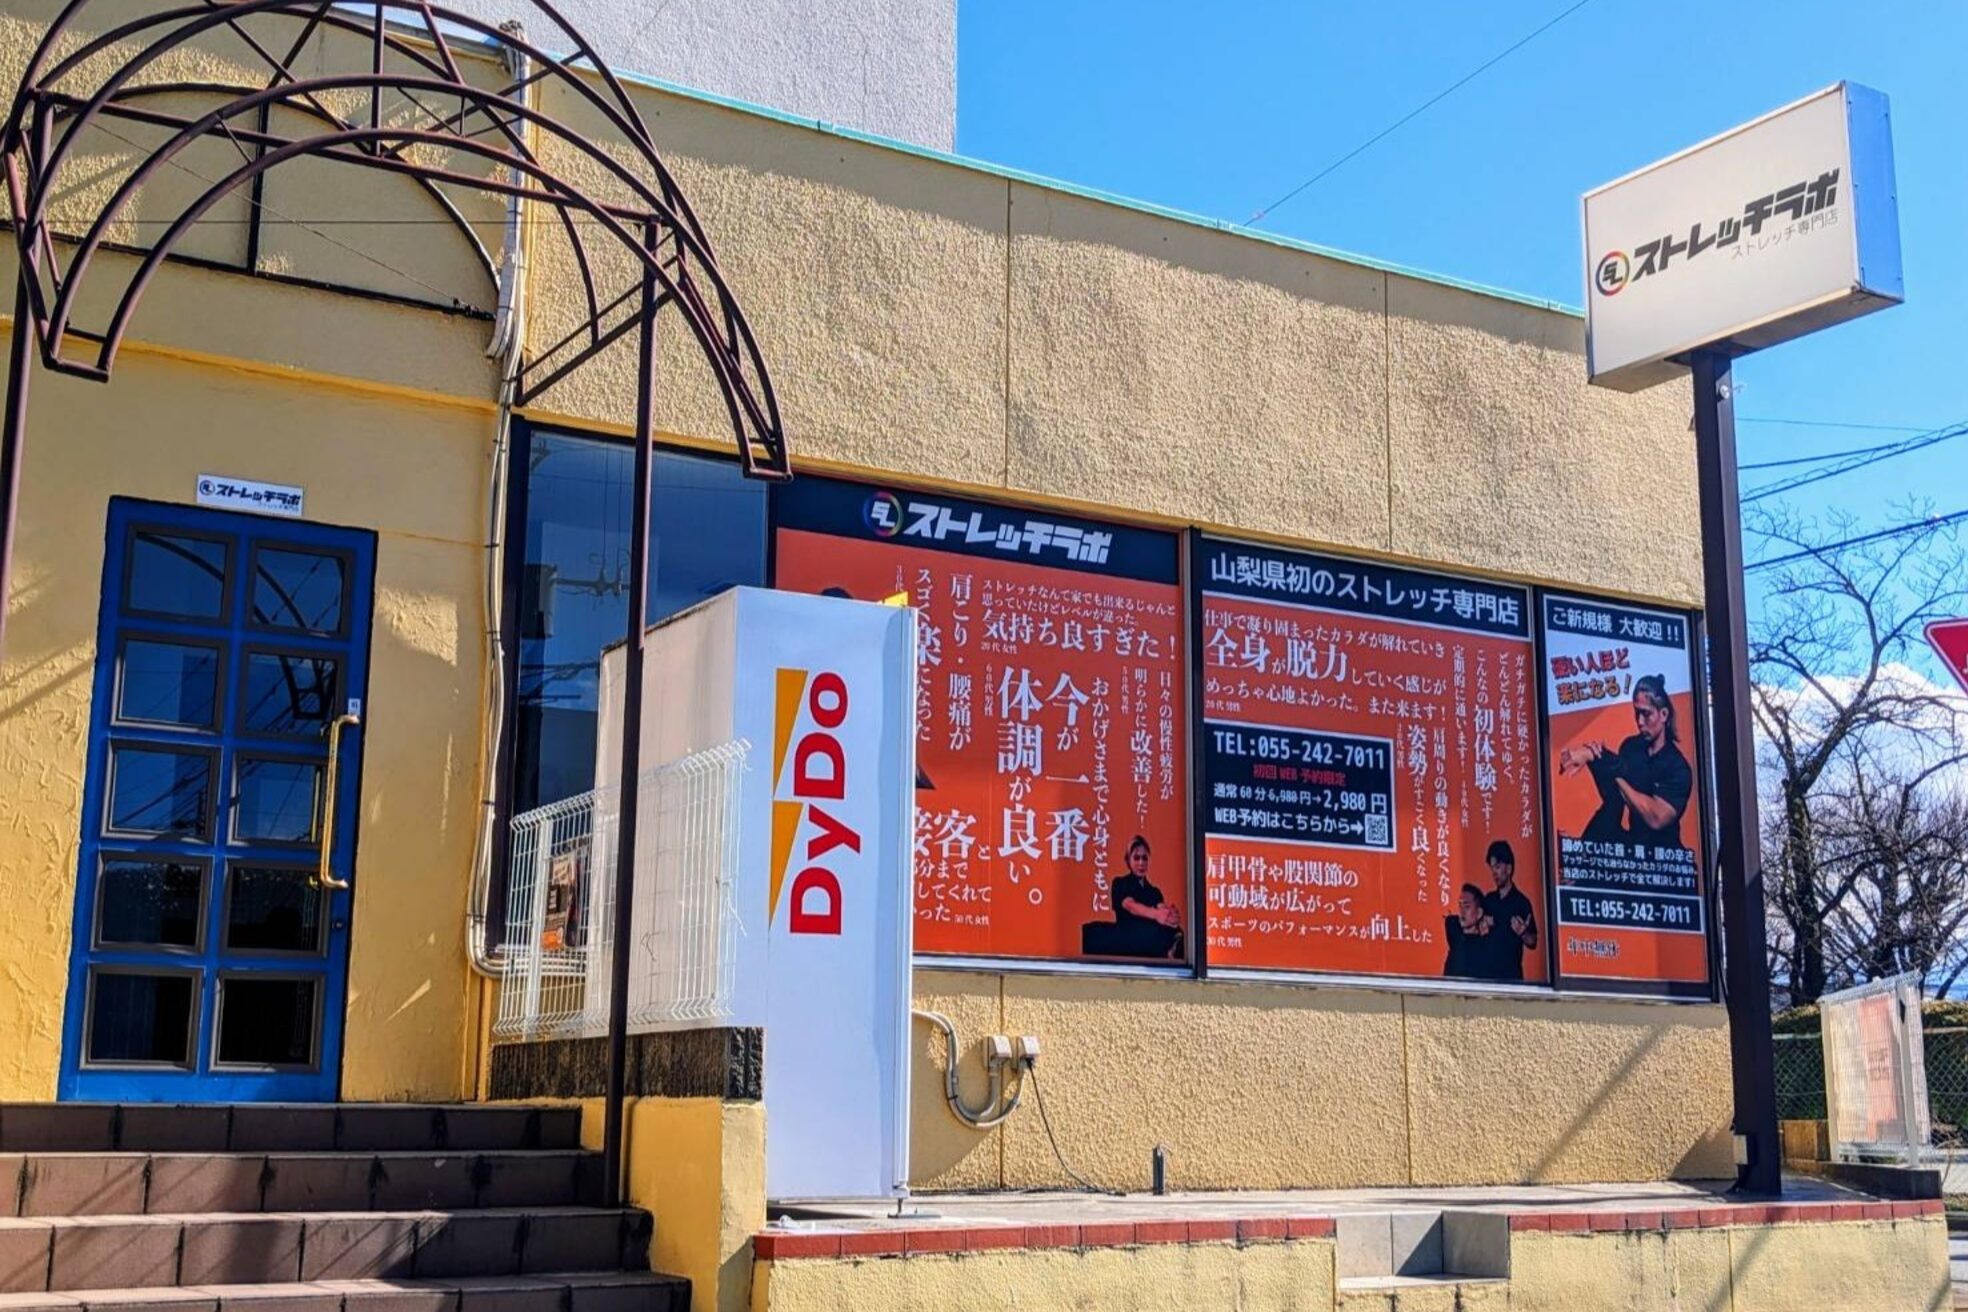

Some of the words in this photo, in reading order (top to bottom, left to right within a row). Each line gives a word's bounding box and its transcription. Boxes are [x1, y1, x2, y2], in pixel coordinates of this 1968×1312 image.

[1631, 168, 1840, 283] ストレッチラボ
[1731, 210, 1839, 259] ストレッチ専門店
[216, 484, 301, 505] ストレッチラボ
[903, 502, 1112, 564] ストレッチラボ
[983, 579, 1176, 616] ストレッチなんて家でも出来るじゃんと
[1211, 552, 1519, 626] 山梨県初のストレッチ専門店
[949, 574, 973, 751] 肩こり・腰痛が
[1551, 646, 1630, 679] い人ほど
[1045, 672, 1090, 861] 今が一番
[1213, 730, 1385, 769] TEL:055-242-7011
[789, 671, 862, 935] DyDo
[997, 666, 1043, 906] 体調が良い。
[1206, 853, 1358, 888] 肩甲骨や股関節の
[1207, 883, 1352, 916] 可動域が広がって
[1570, 897, 1691, 924] TEL:055-242-7011
